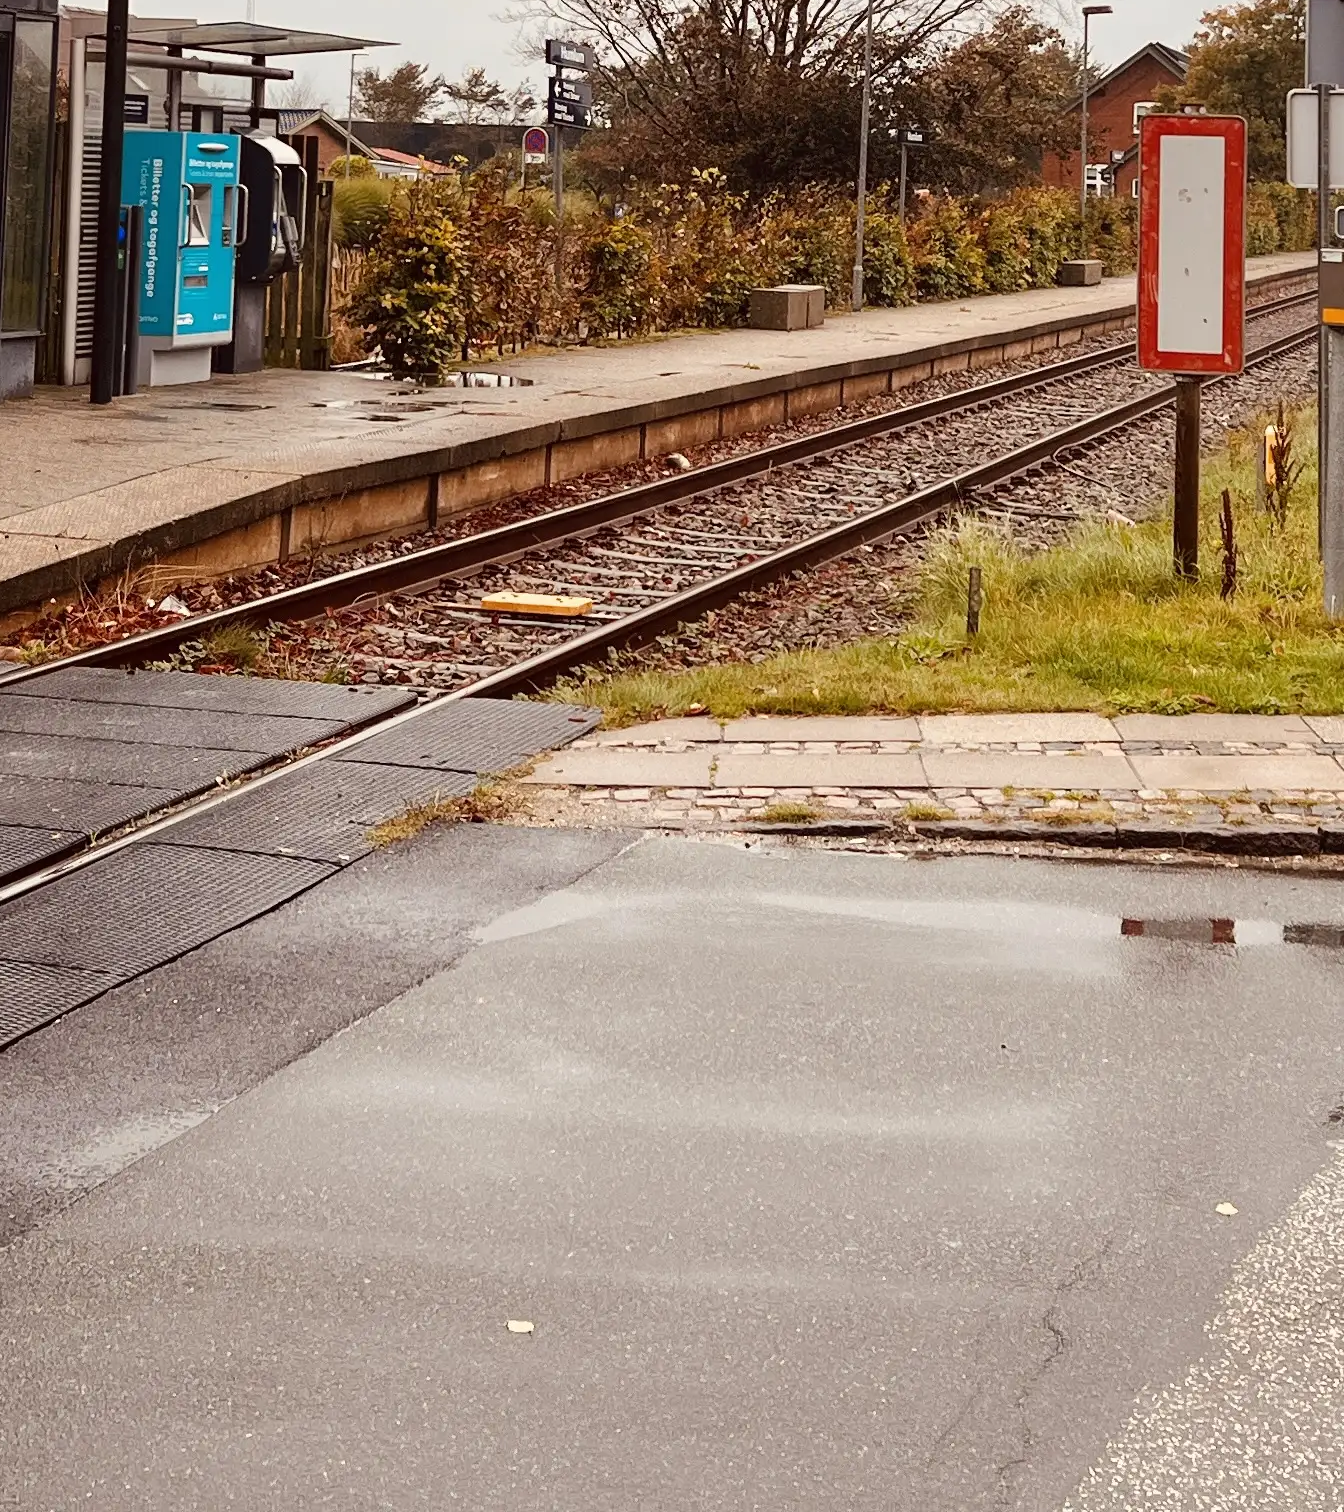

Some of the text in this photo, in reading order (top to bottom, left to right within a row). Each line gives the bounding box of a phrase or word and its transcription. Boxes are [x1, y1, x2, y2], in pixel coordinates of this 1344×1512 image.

[140, 158, 150, 196] Tickets
[151, 159, 163, 207] Billetter
[148, 209, 158, 225] og
